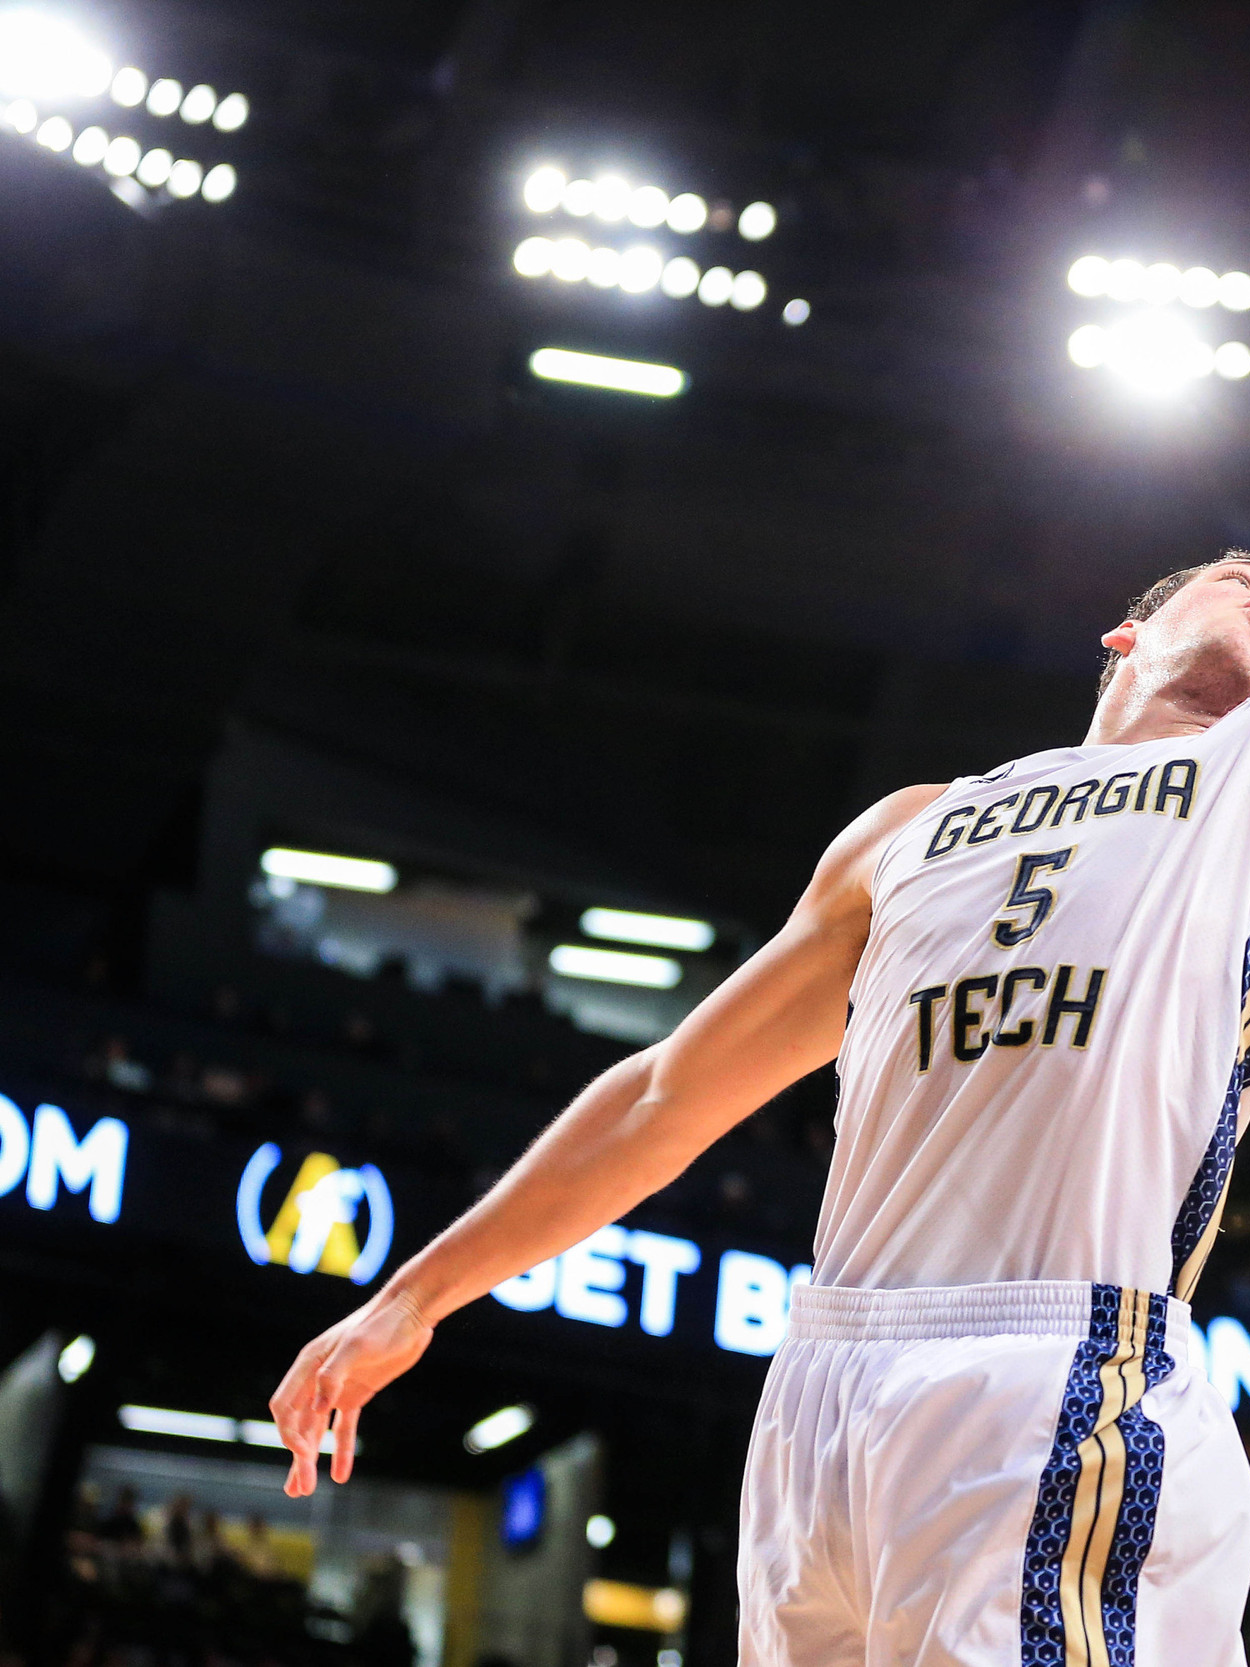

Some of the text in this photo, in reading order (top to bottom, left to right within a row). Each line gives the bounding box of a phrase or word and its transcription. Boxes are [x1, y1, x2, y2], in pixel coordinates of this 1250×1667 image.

[922, 758, 1199, 862] GEORGIA
[991, 843, 1078, 951] 5
[908, 963, 1110, 1076] TECH
